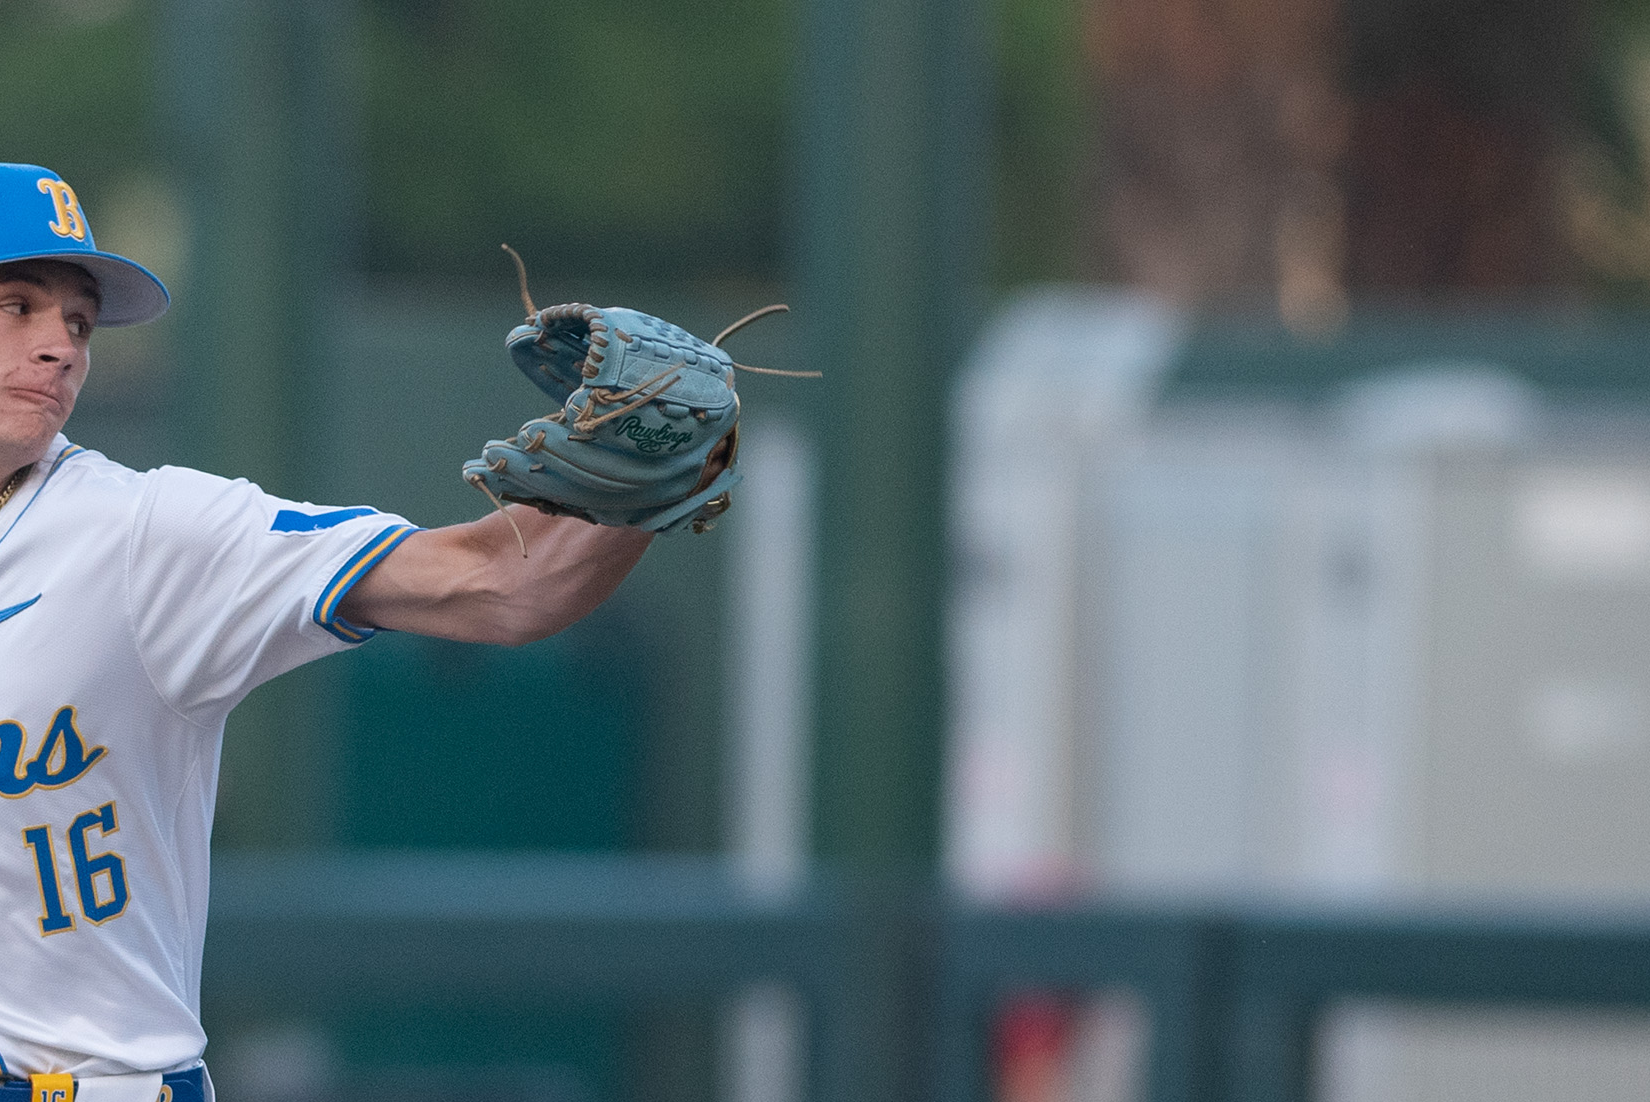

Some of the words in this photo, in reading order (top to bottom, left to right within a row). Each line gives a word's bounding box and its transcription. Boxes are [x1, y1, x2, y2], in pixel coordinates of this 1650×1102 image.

[37, 178, 86, 241] B
[615, 415, 693, 453] Rawlings
[21, 800, 132, 937] 16
